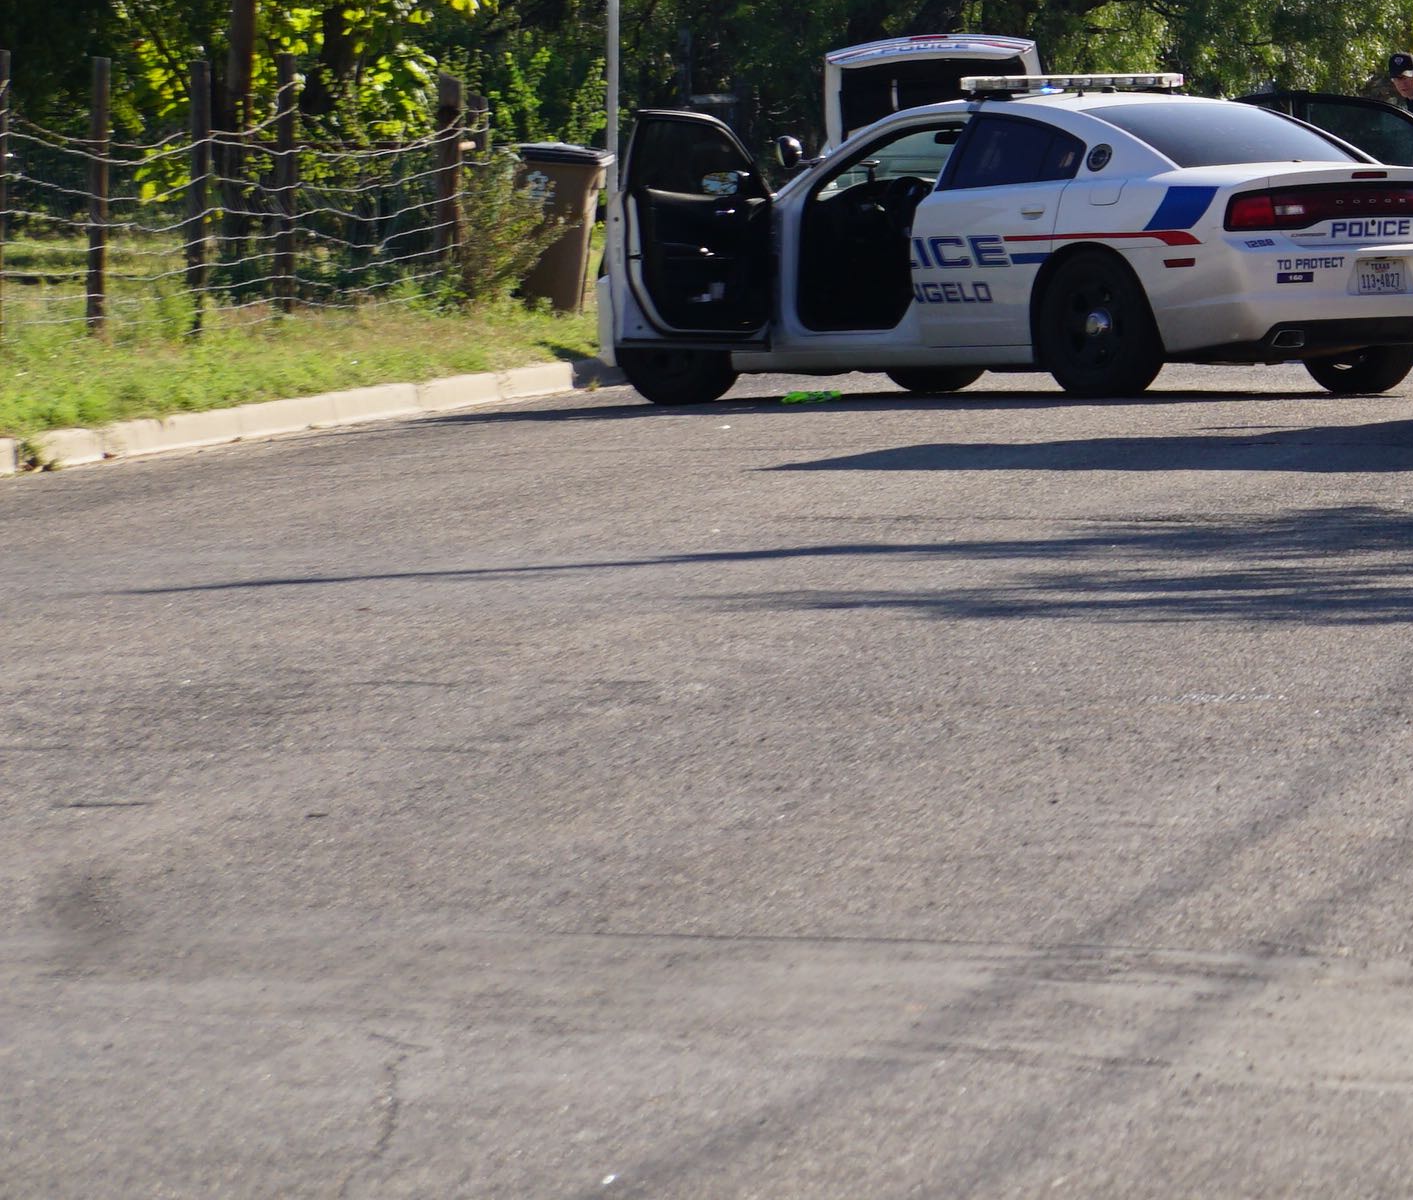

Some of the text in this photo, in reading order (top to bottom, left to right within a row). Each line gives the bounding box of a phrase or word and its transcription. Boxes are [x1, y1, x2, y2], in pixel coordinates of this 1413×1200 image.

[1331, 219, 1411, 239] POLICE
[1277, 256, 1345, 270] TO PROTECT
